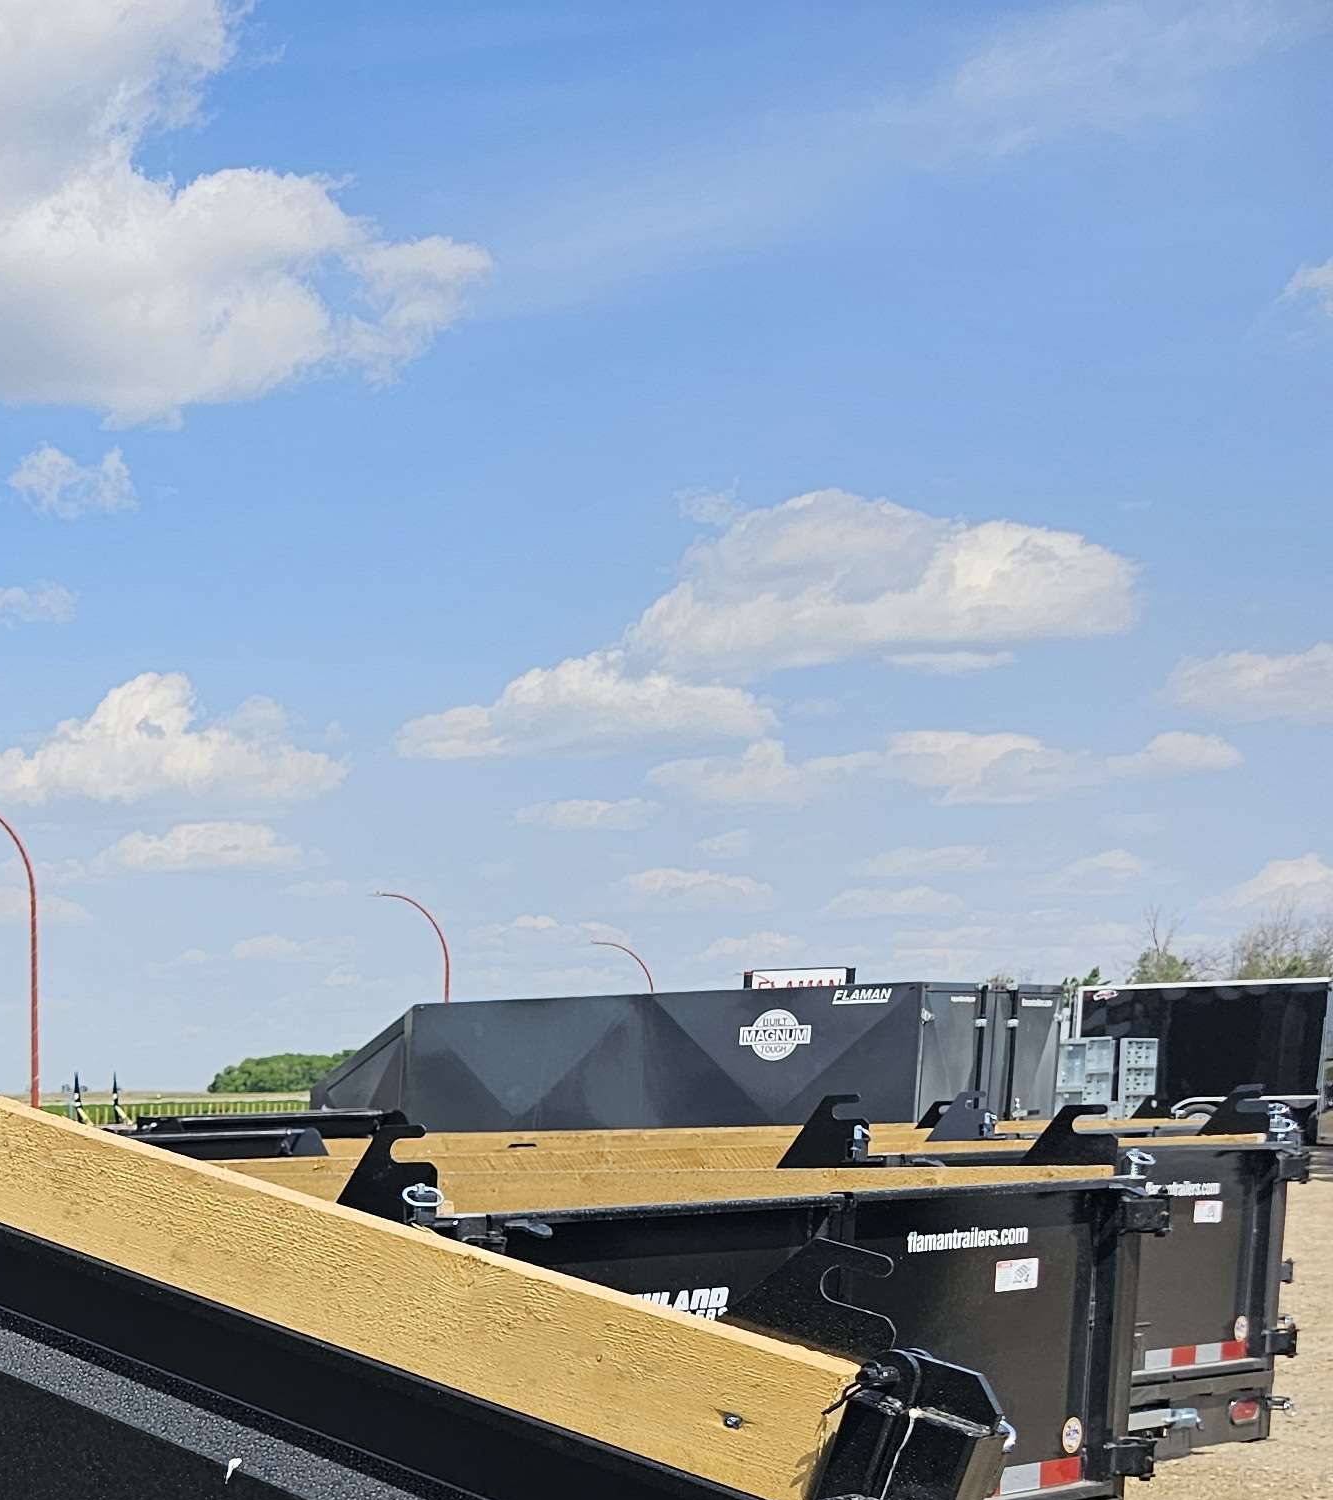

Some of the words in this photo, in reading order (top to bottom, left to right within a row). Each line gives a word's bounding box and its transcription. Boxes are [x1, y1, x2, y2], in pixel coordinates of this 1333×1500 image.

[834, 988, 892, 1001] FLAMAN
[743, 1029, 806, 1043] MAGNUM
[907, 1227, 1029, 1253] flamantrailers.com
